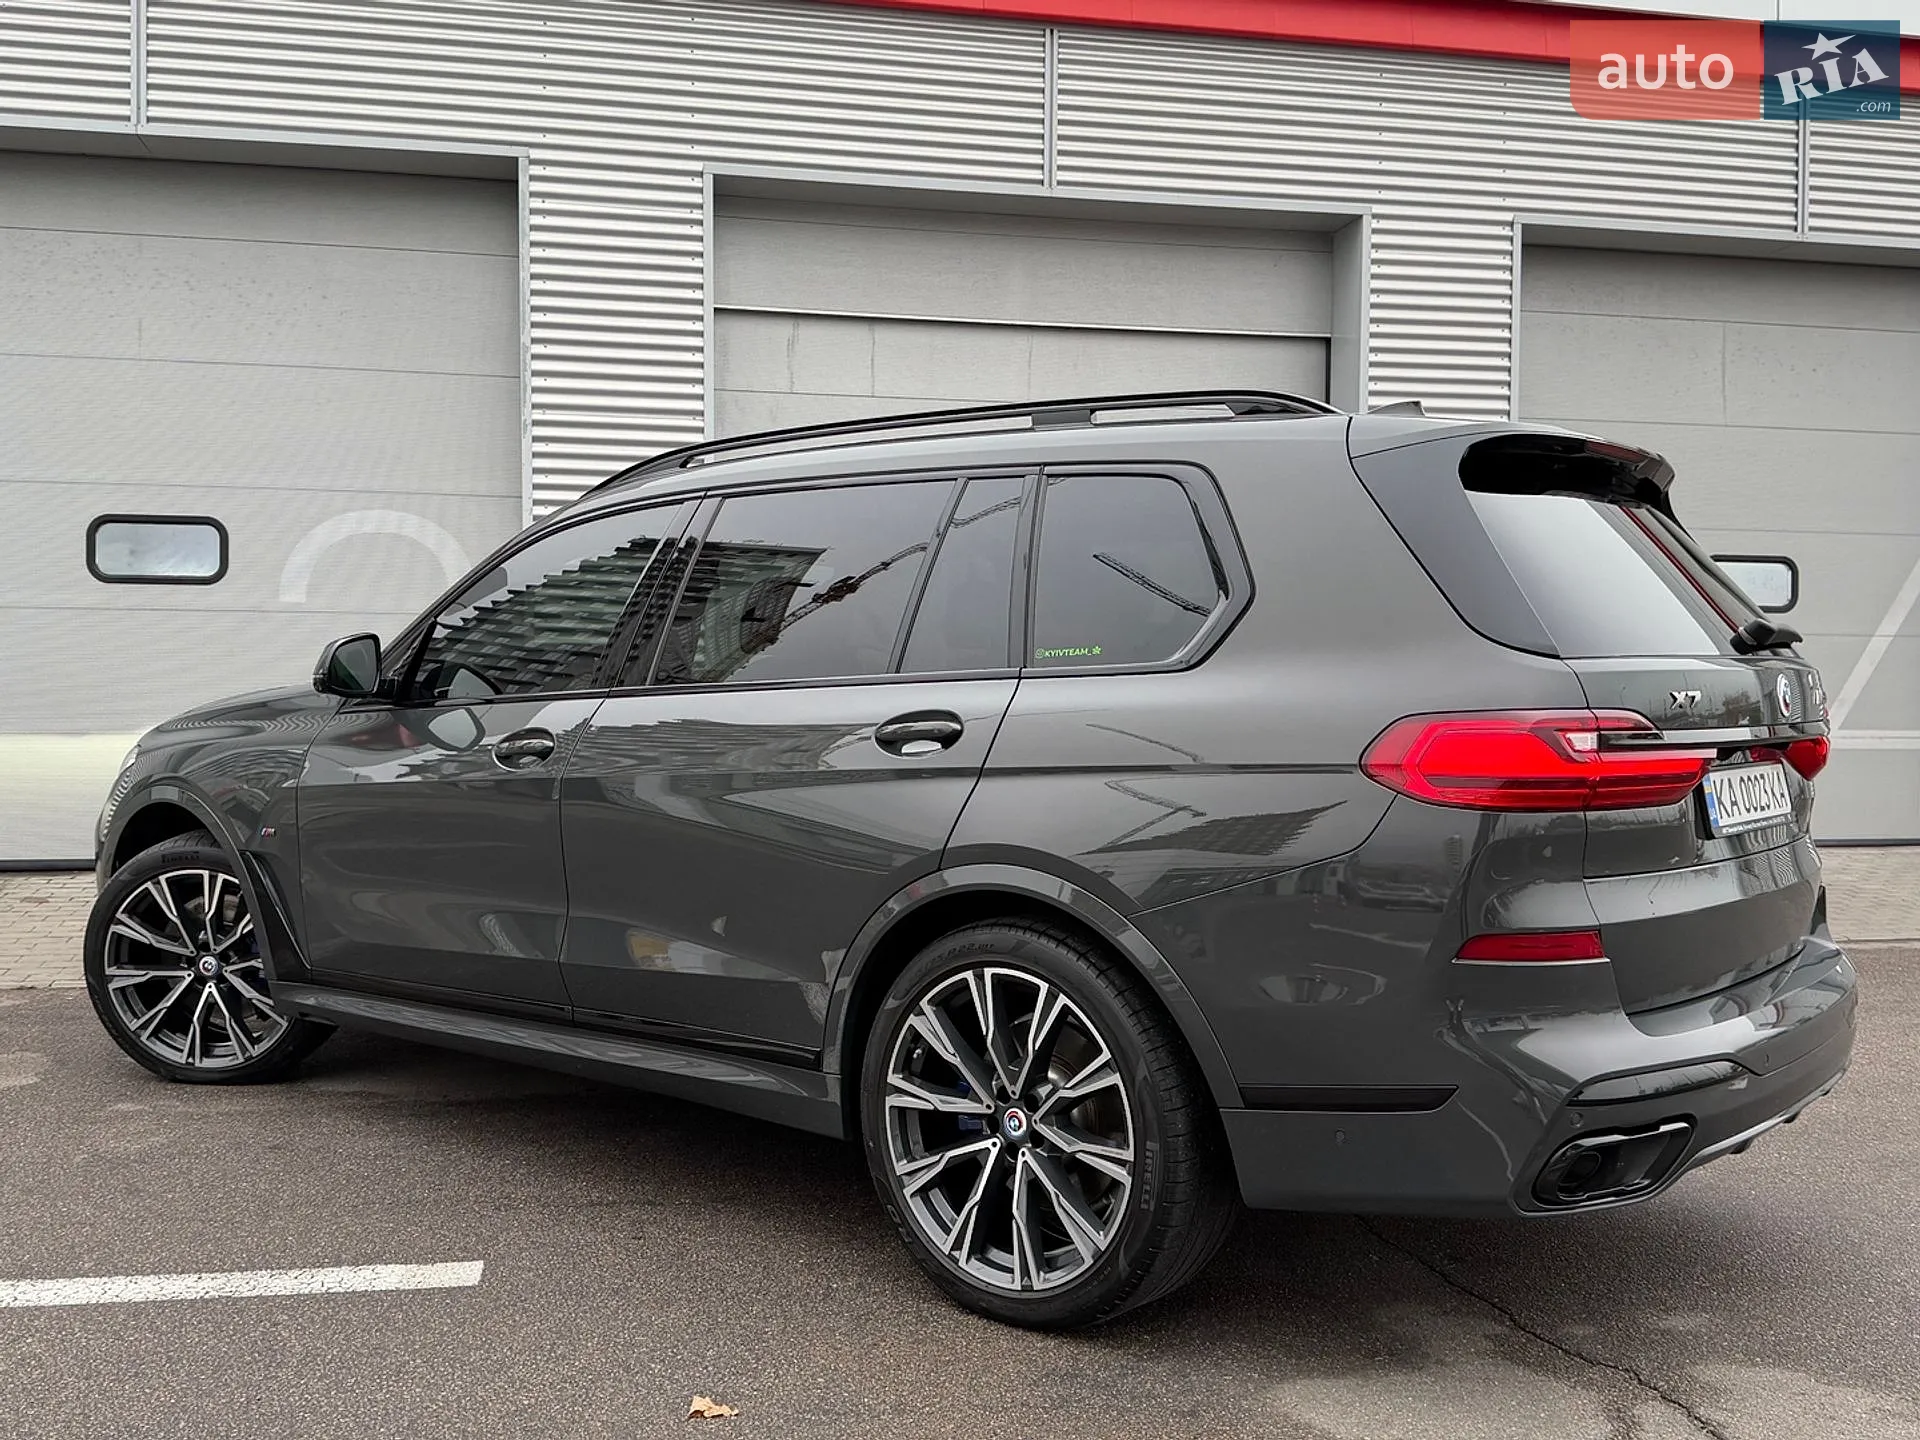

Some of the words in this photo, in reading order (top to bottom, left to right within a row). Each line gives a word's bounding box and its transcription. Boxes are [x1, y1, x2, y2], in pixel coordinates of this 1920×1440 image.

[1669, 690, 1702, 710] X7
[1713, 777, 1741, 819] KA
[1739, 773, 1771, 813] 0023
[1767, 771, 1788, 808] KA
